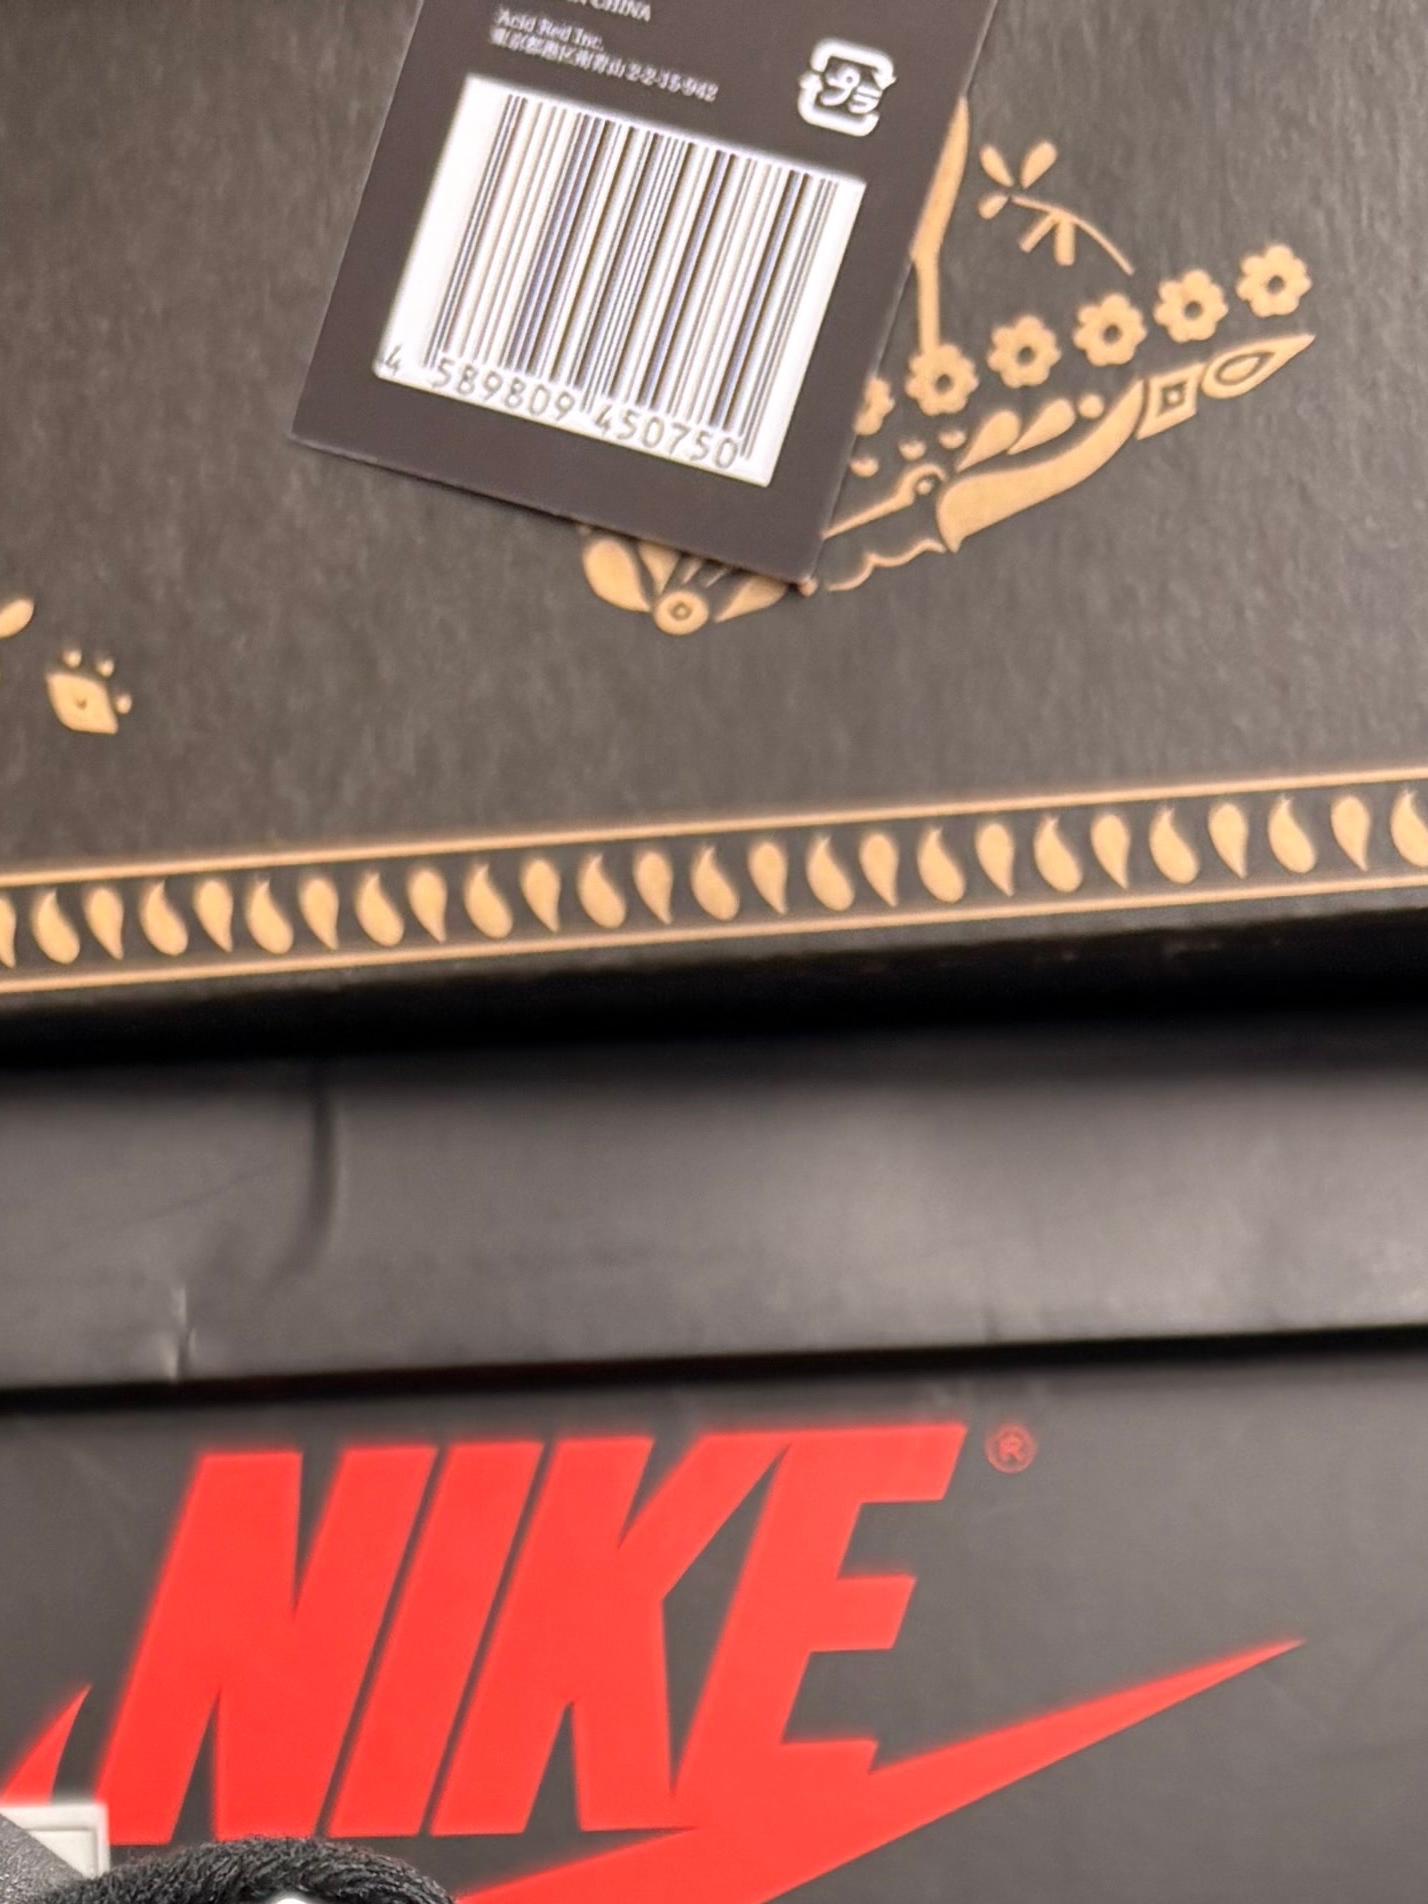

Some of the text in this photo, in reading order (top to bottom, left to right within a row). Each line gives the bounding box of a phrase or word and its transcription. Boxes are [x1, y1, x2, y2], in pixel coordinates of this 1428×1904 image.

[430, 354, 576, 423] 589809
[593, 408, 740, 470] 450750
[94, 1422, 969, 1847] NIKE
